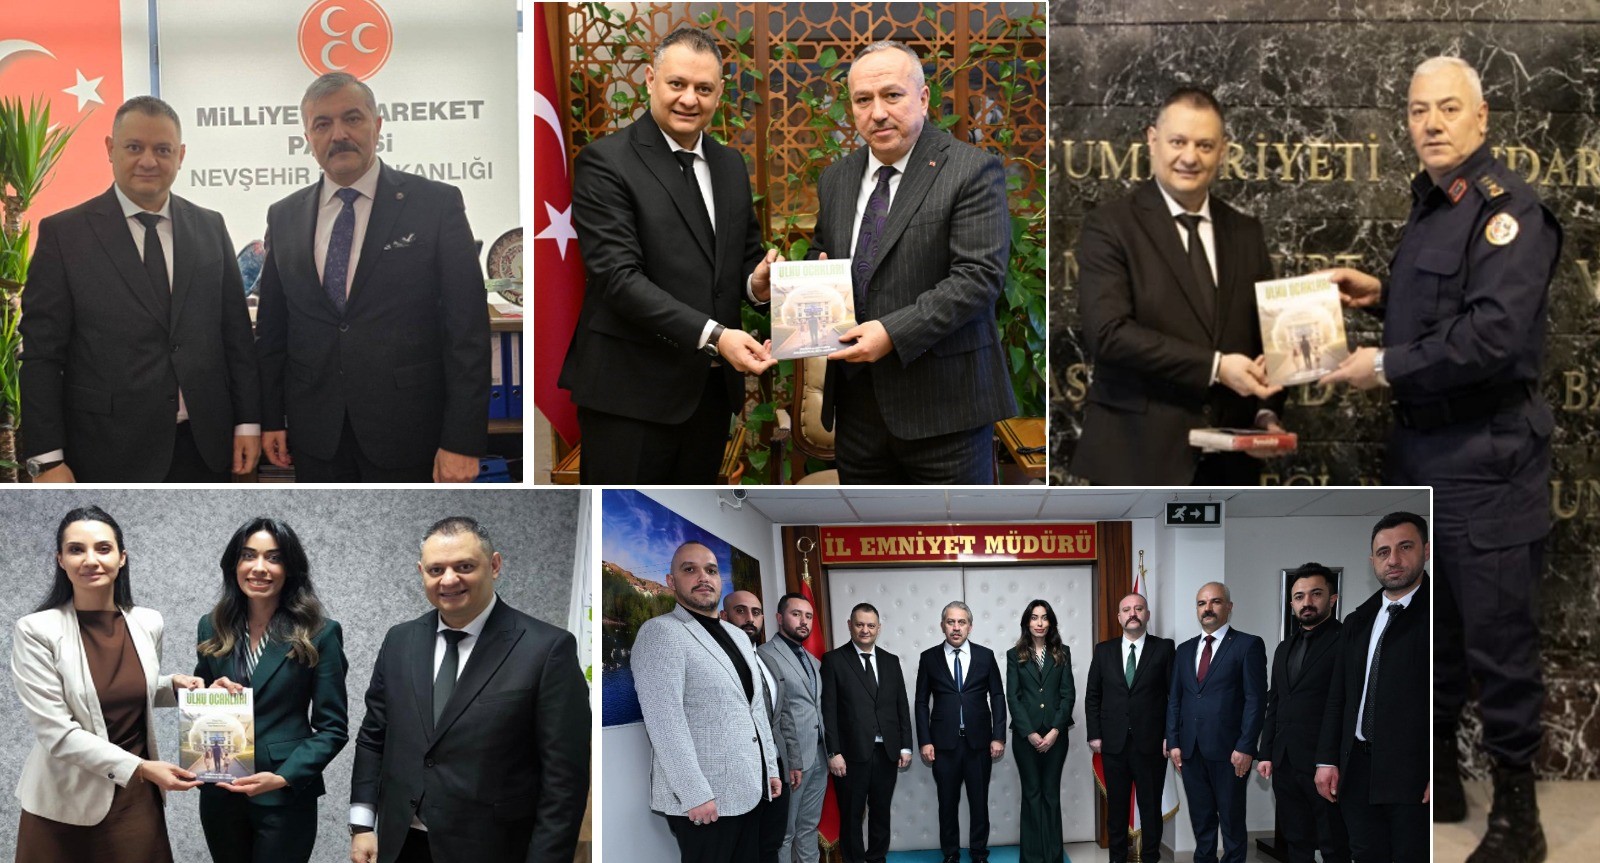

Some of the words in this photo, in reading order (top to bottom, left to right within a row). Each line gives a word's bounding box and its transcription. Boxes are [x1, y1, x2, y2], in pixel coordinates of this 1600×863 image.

[196, 105, 299, 127] MiLLiYE
[377, 100, 484, 122] AREKET
[825, 532, 852, 557] İL
[859, 531, 976, 556] EMNİYET
[984, 530, 1092, 555] MÜDÜRÜ
